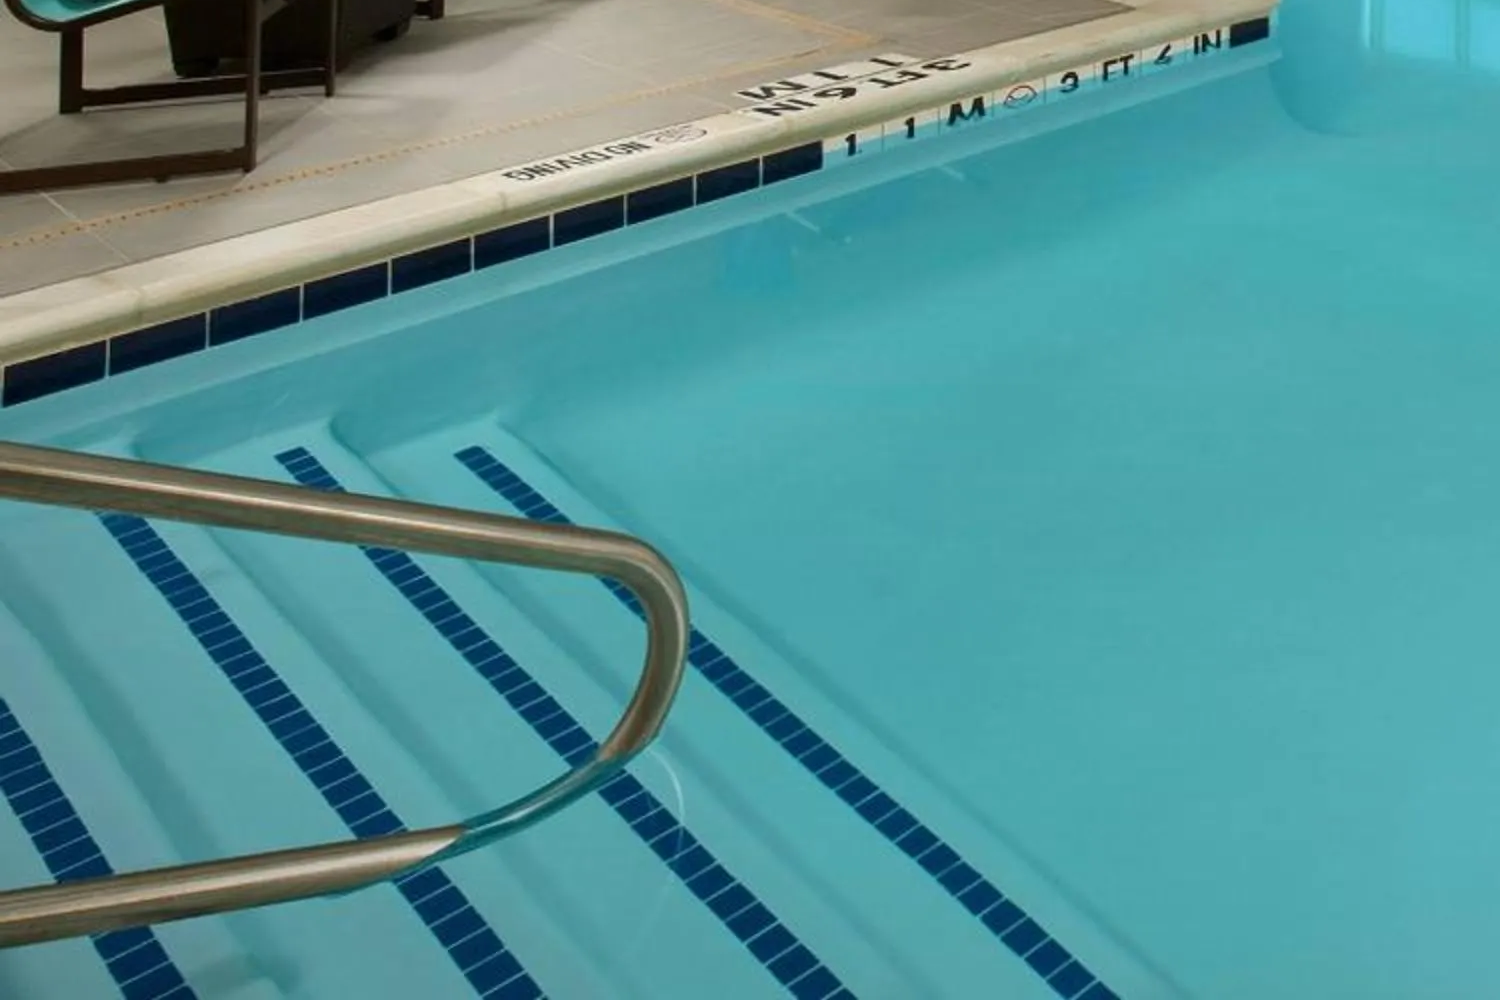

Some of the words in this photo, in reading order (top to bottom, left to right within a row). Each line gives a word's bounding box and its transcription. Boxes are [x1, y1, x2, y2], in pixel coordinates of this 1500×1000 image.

[947, 96, 986, 126] M
[1060, 71, 1080, 93] 3
[1102, 53, 1135, 82] FT
[1154, 43, 1172, 65] 6
[1193, 29, 1222, 56] IN
[737, 80, 809, 101] M
[753, 99, 818, 116] IN
[605, 140, 653, 155] NO
[501, 151, 613, 180] DIVING
